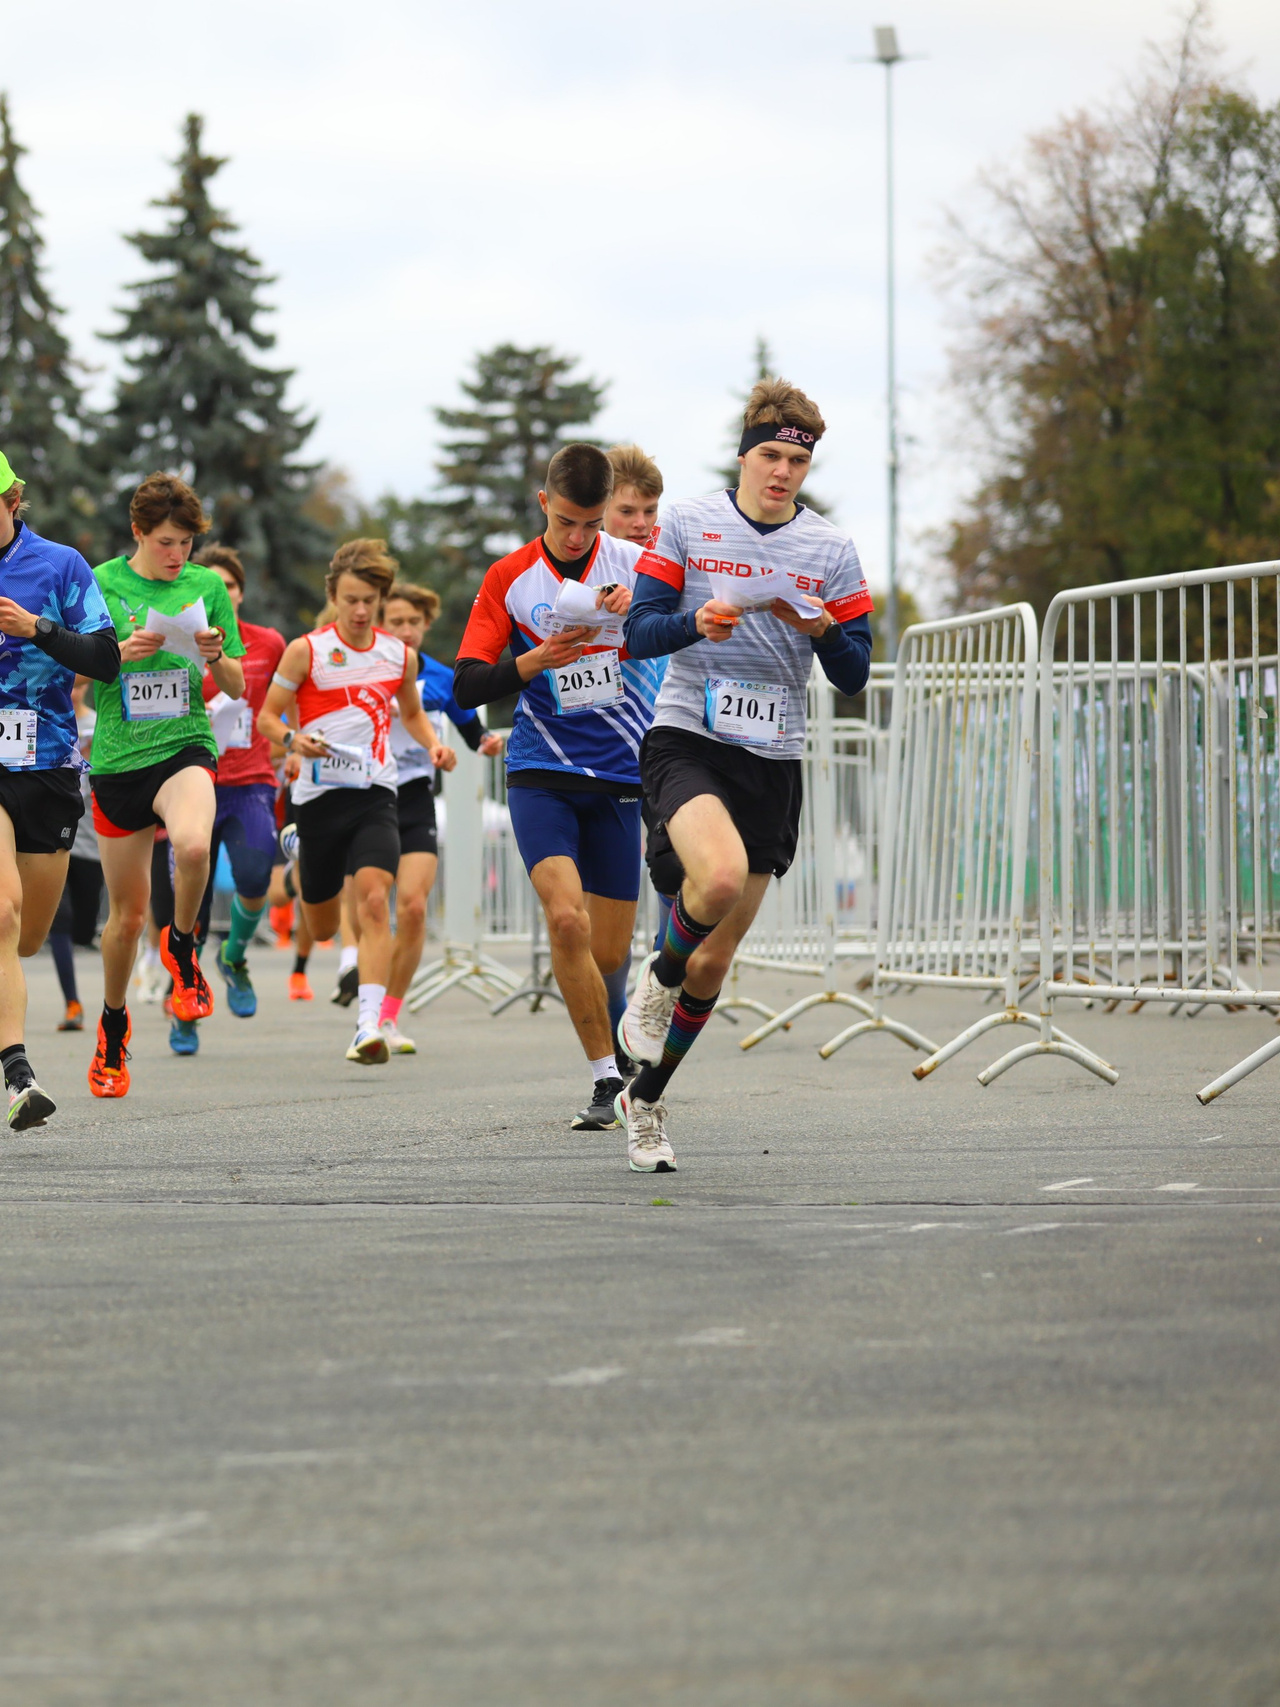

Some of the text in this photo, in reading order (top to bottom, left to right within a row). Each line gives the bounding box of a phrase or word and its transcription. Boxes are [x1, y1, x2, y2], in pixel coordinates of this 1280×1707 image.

[4, 538, 24, 563] noname
[687, 556, 824, 593] NORD ST
[131, 682, 178, 701] 207.1
[558, 665, 613, 693] 203.1
[720, 694, 776, 723] 210.1
[619, 795, 638, 803] adidas
